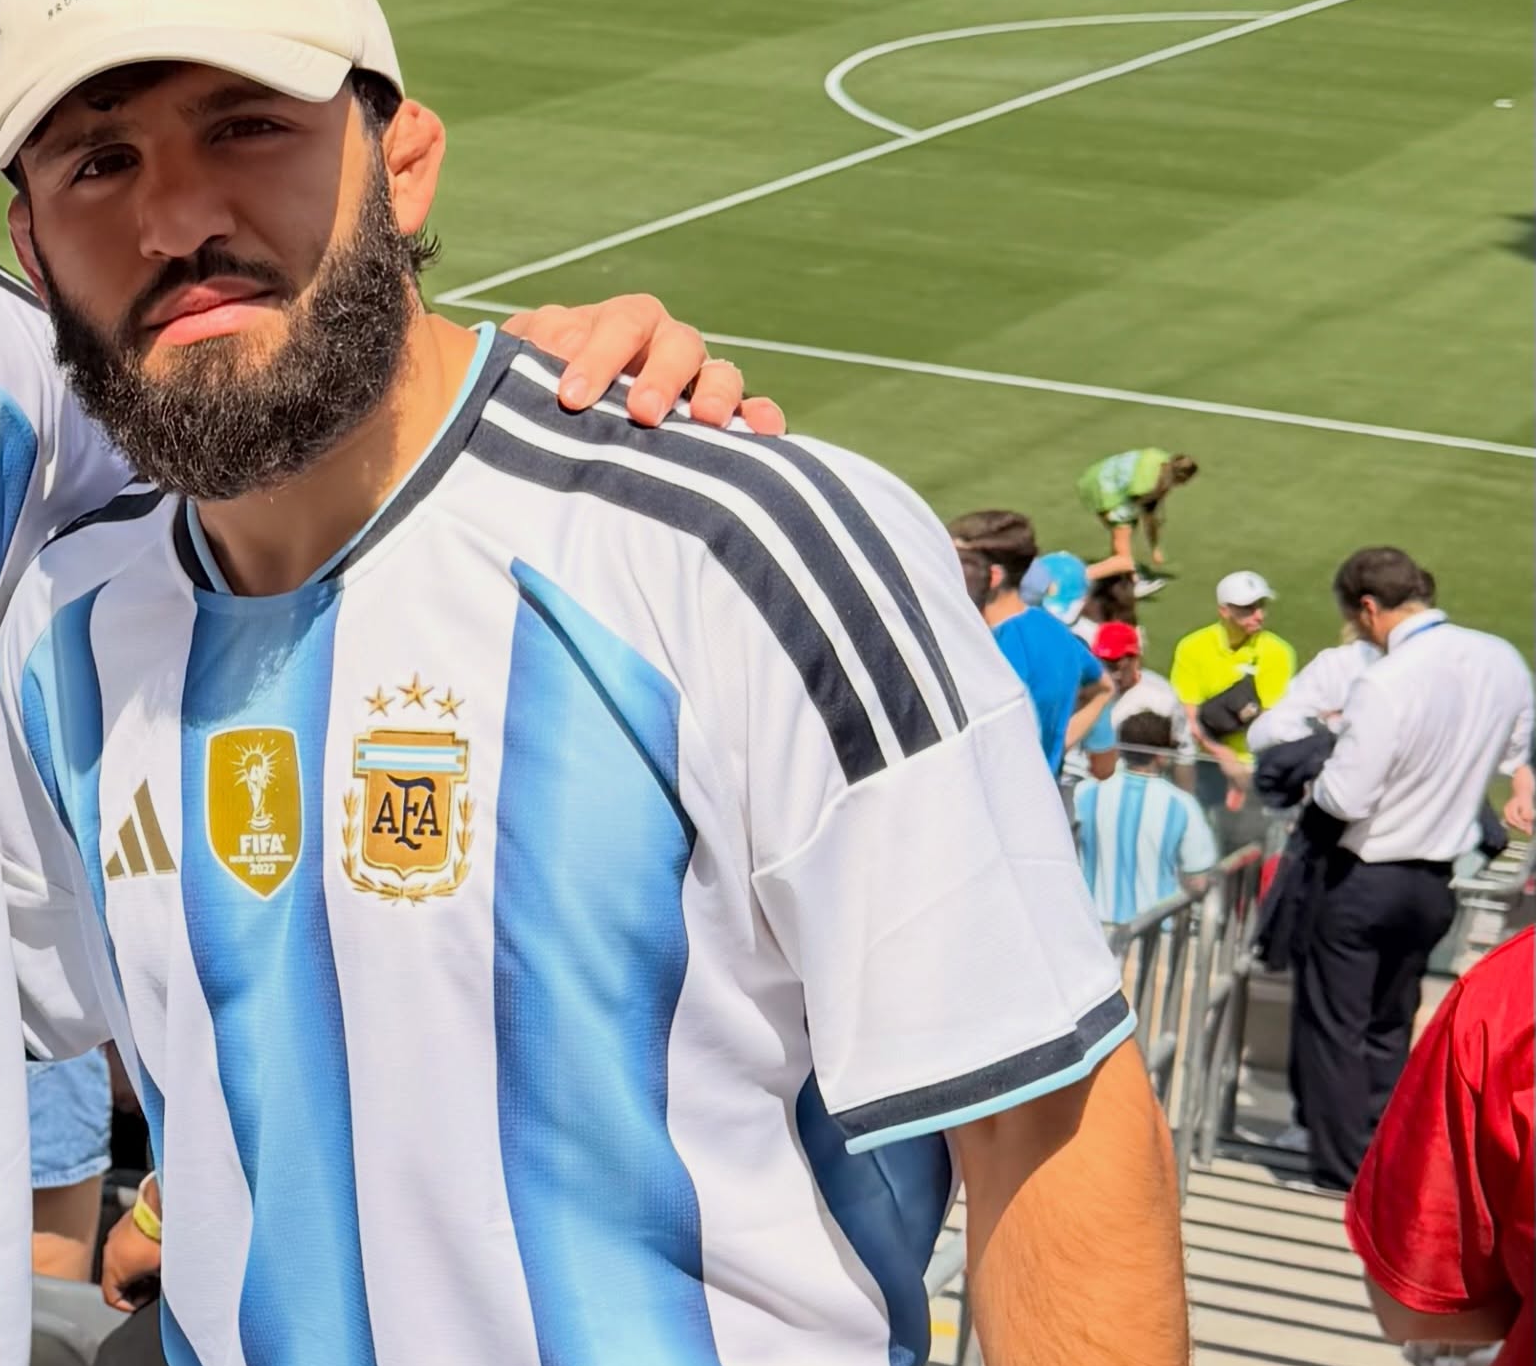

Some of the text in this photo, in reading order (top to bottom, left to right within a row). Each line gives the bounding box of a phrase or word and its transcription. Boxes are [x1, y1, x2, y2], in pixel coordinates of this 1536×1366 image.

[371, 773, 443, 851] AFA
[239, 834, 285, 855] FIFA
[248, 863, 277, 876] 2022
